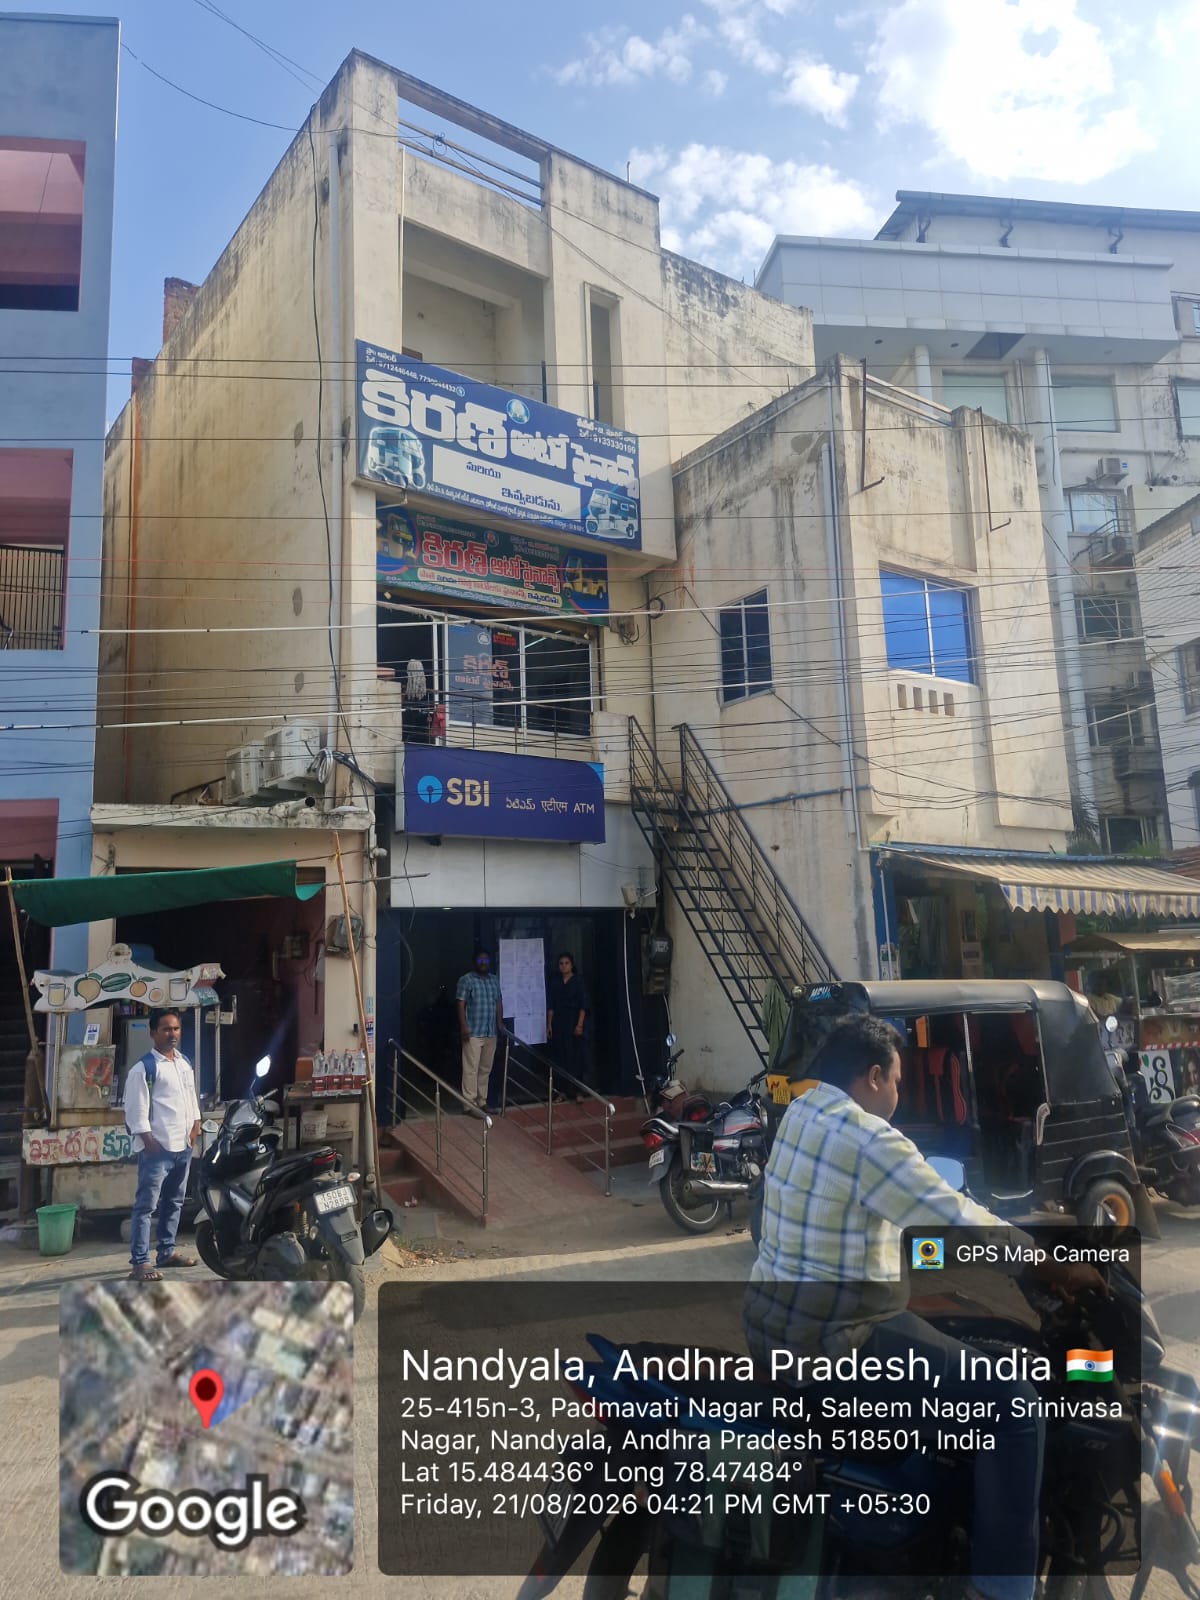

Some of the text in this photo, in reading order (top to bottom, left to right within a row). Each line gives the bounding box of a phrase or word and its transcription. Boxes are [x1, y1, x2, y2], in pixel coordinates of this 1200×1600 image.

[361, 368, 507, 459] కిరణ్
[510, 427, 570, 470] ఆటో
[466, 461, 502, 480] మరియు
[422, 531, 488, 577] కిరణ్
[490, 554, 521, 580] ఆటో
[446, 777, 490, 807] SBI
[540, 797, 569, 813] एटीएम
[573, 802, 595, 814] ATM
